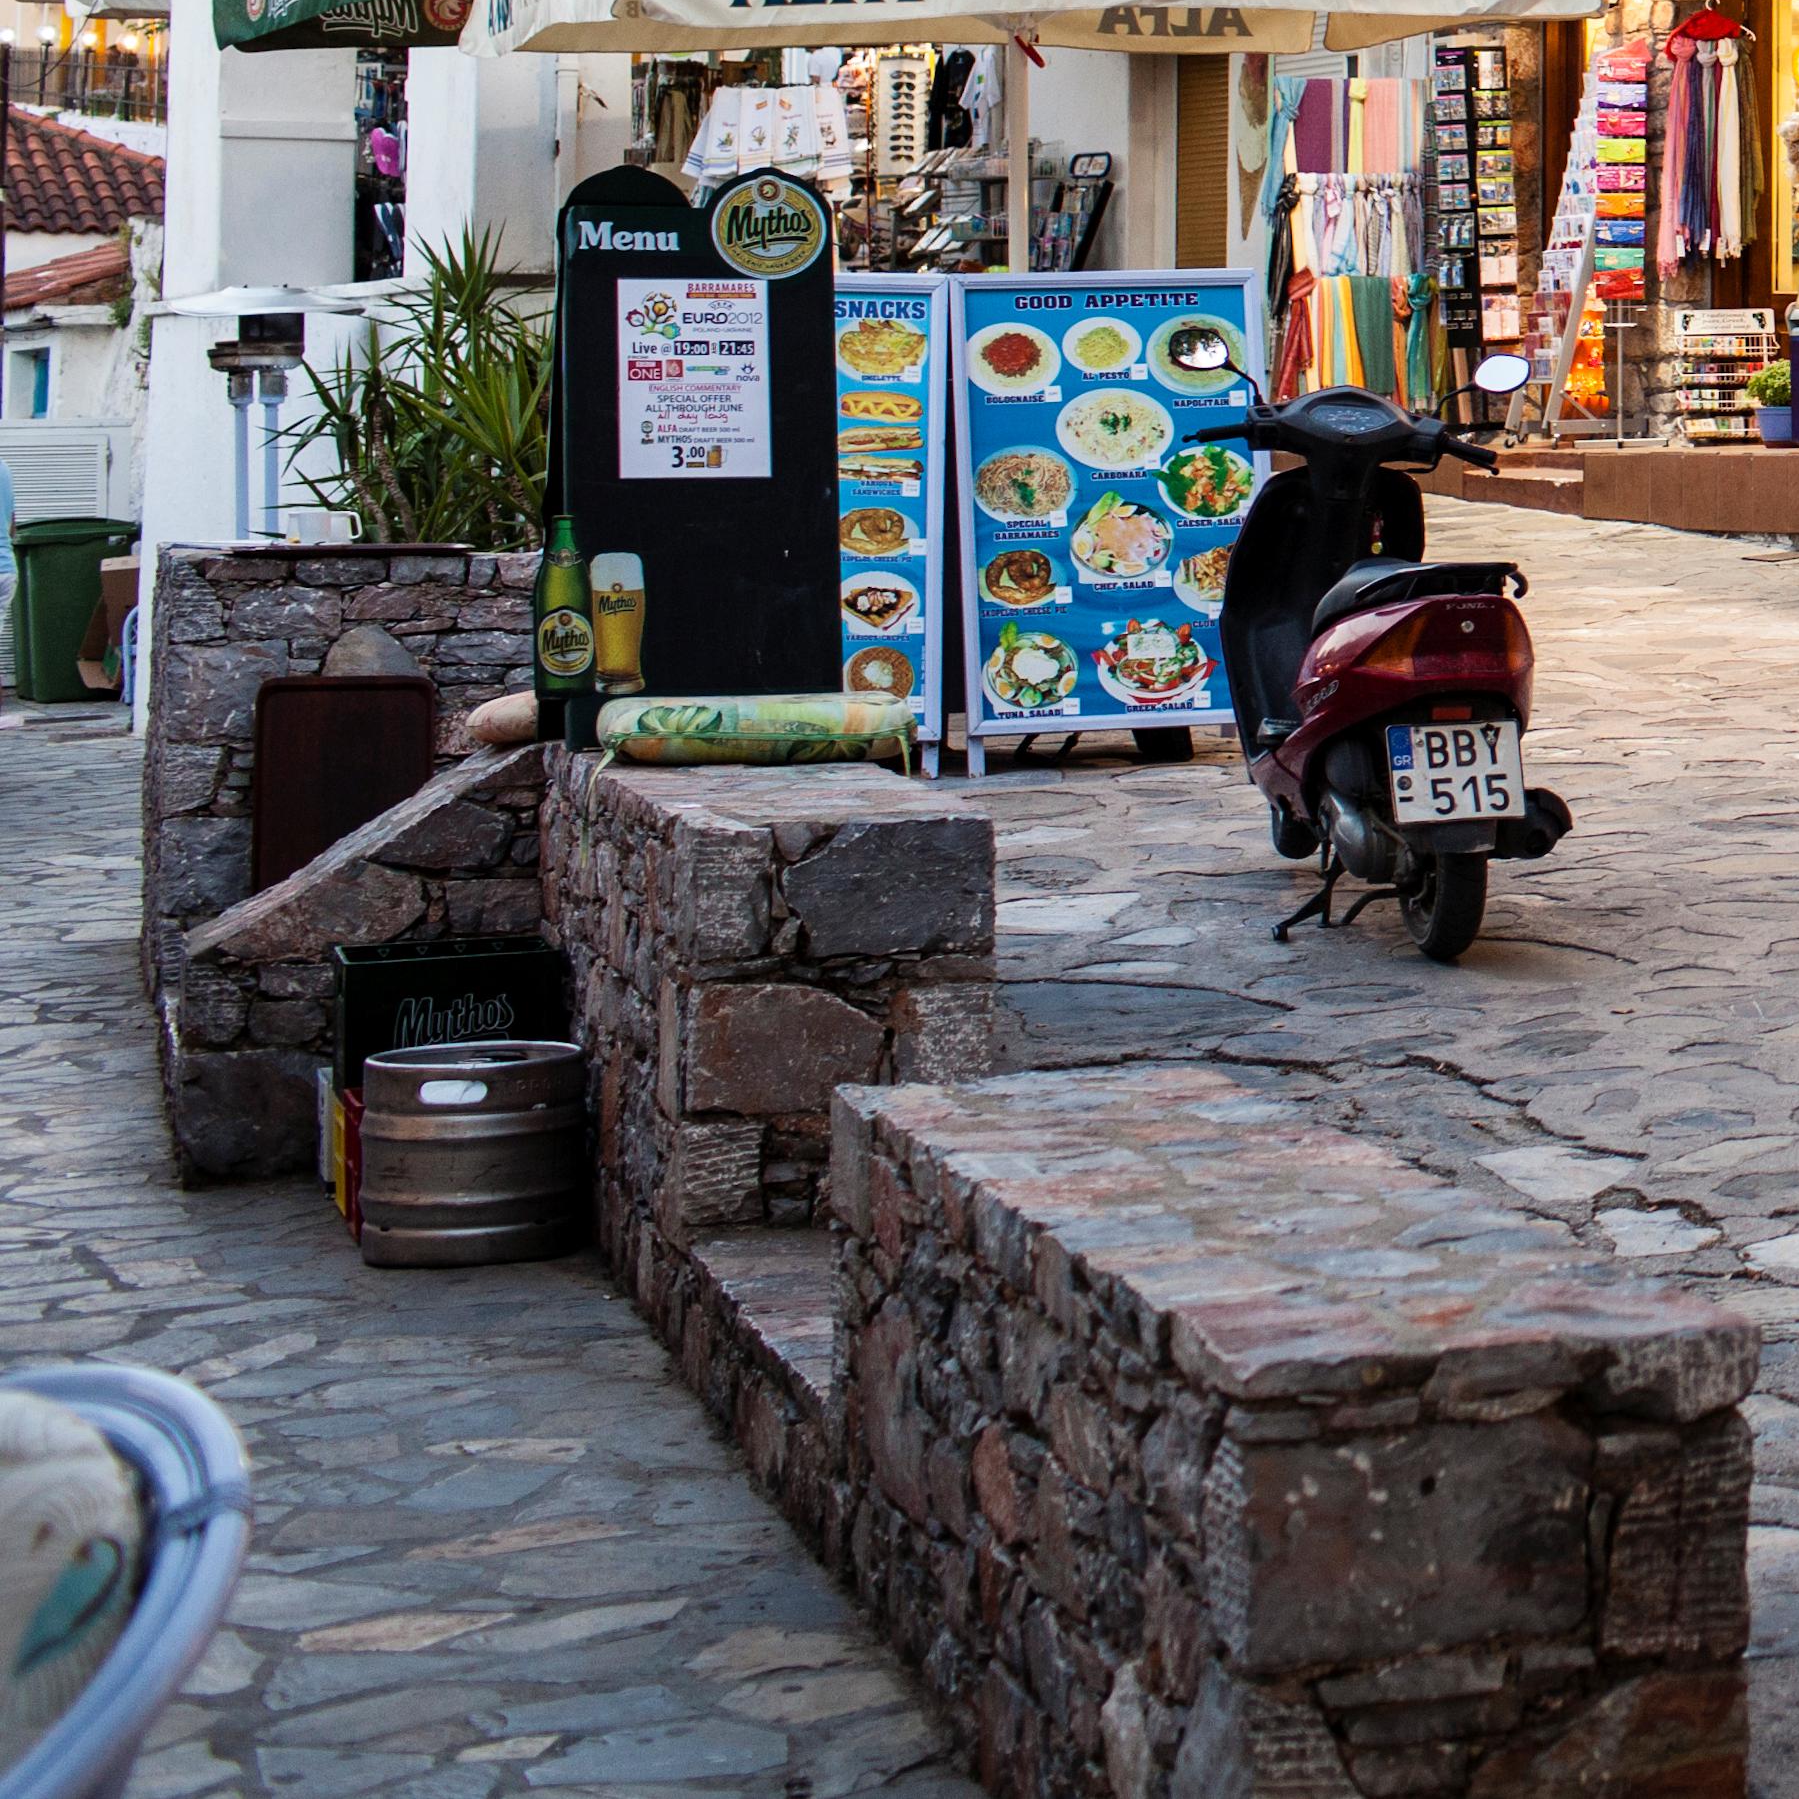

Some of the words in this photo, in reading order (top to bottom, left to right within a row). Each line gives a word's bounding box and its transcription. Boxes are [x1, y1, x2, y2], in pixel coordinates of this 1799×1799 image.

[727, 204, 812, 250] Mythos
[578, 220, 680, 251] Menu
[687, 283, 756, 293] BARRAMARES
[710, 301, 734, 310] UEFA
[1014, 295, 1073, 310] GOOD
[1084, 292, 1199, 308] APPETITE
[834, 300, 926, 319] SNACKS
[682, 312, 763, 325] EURO2012
[632, 342, 658, 355] Live
[661, 343, 672, 356] @
[675, 343, 708, 355] 19:00
[723, 343, 755, 355] 21:45
[629, 369, 662, 380] ONE
[736, 374, 760, 382] nova
[1082, 372, 1095, 380] AL
[1099, 371, 1130, 380] PESTO
[649, 384, 684, 392] ENGLISH
[685, 384, 742, 392] COMMENTARY
[657, 395, 697, 403] SPECIAL
[700, 395, 732, 403] OFFER
[985, 395, 1046, 404] BOLOGNAISE
[645, 404, 663, 412] ALL
[667, 404, 716, 412] THROUGH
[718, 404, 743, 412] JUNE
[657, 424, 678, 433] ALFA
[657, 435, 693, 444] MYTHOS
[1091, 471, 1148, 480] CARBONARA
[1006, 520, 1047, 529] SPECIAL
[1176, 518, 1213, 528] CAESER
[994, 530, 1060, 541] BARRAMARES
[1094, 582, 1117, 591] CHEF
[1122, 580, 1154, 590] SALAD
[599, 595, 637, 614] Mythos
[543, 626, 590, 658] Mythos
[1126, 703, 1157, 713] GREEK
[1161, 701, 1194, 711] SALAD
[997, 711, 1024, 720] TUNA
[1028, 709, 1063, 719] SALAD
[1424, 726, 1502, 769] BBY
[1393, 754, 1412, 767] GR
[1430, 773, 1511, 816] 515
[393, 993, 515, 1048] Mythos
